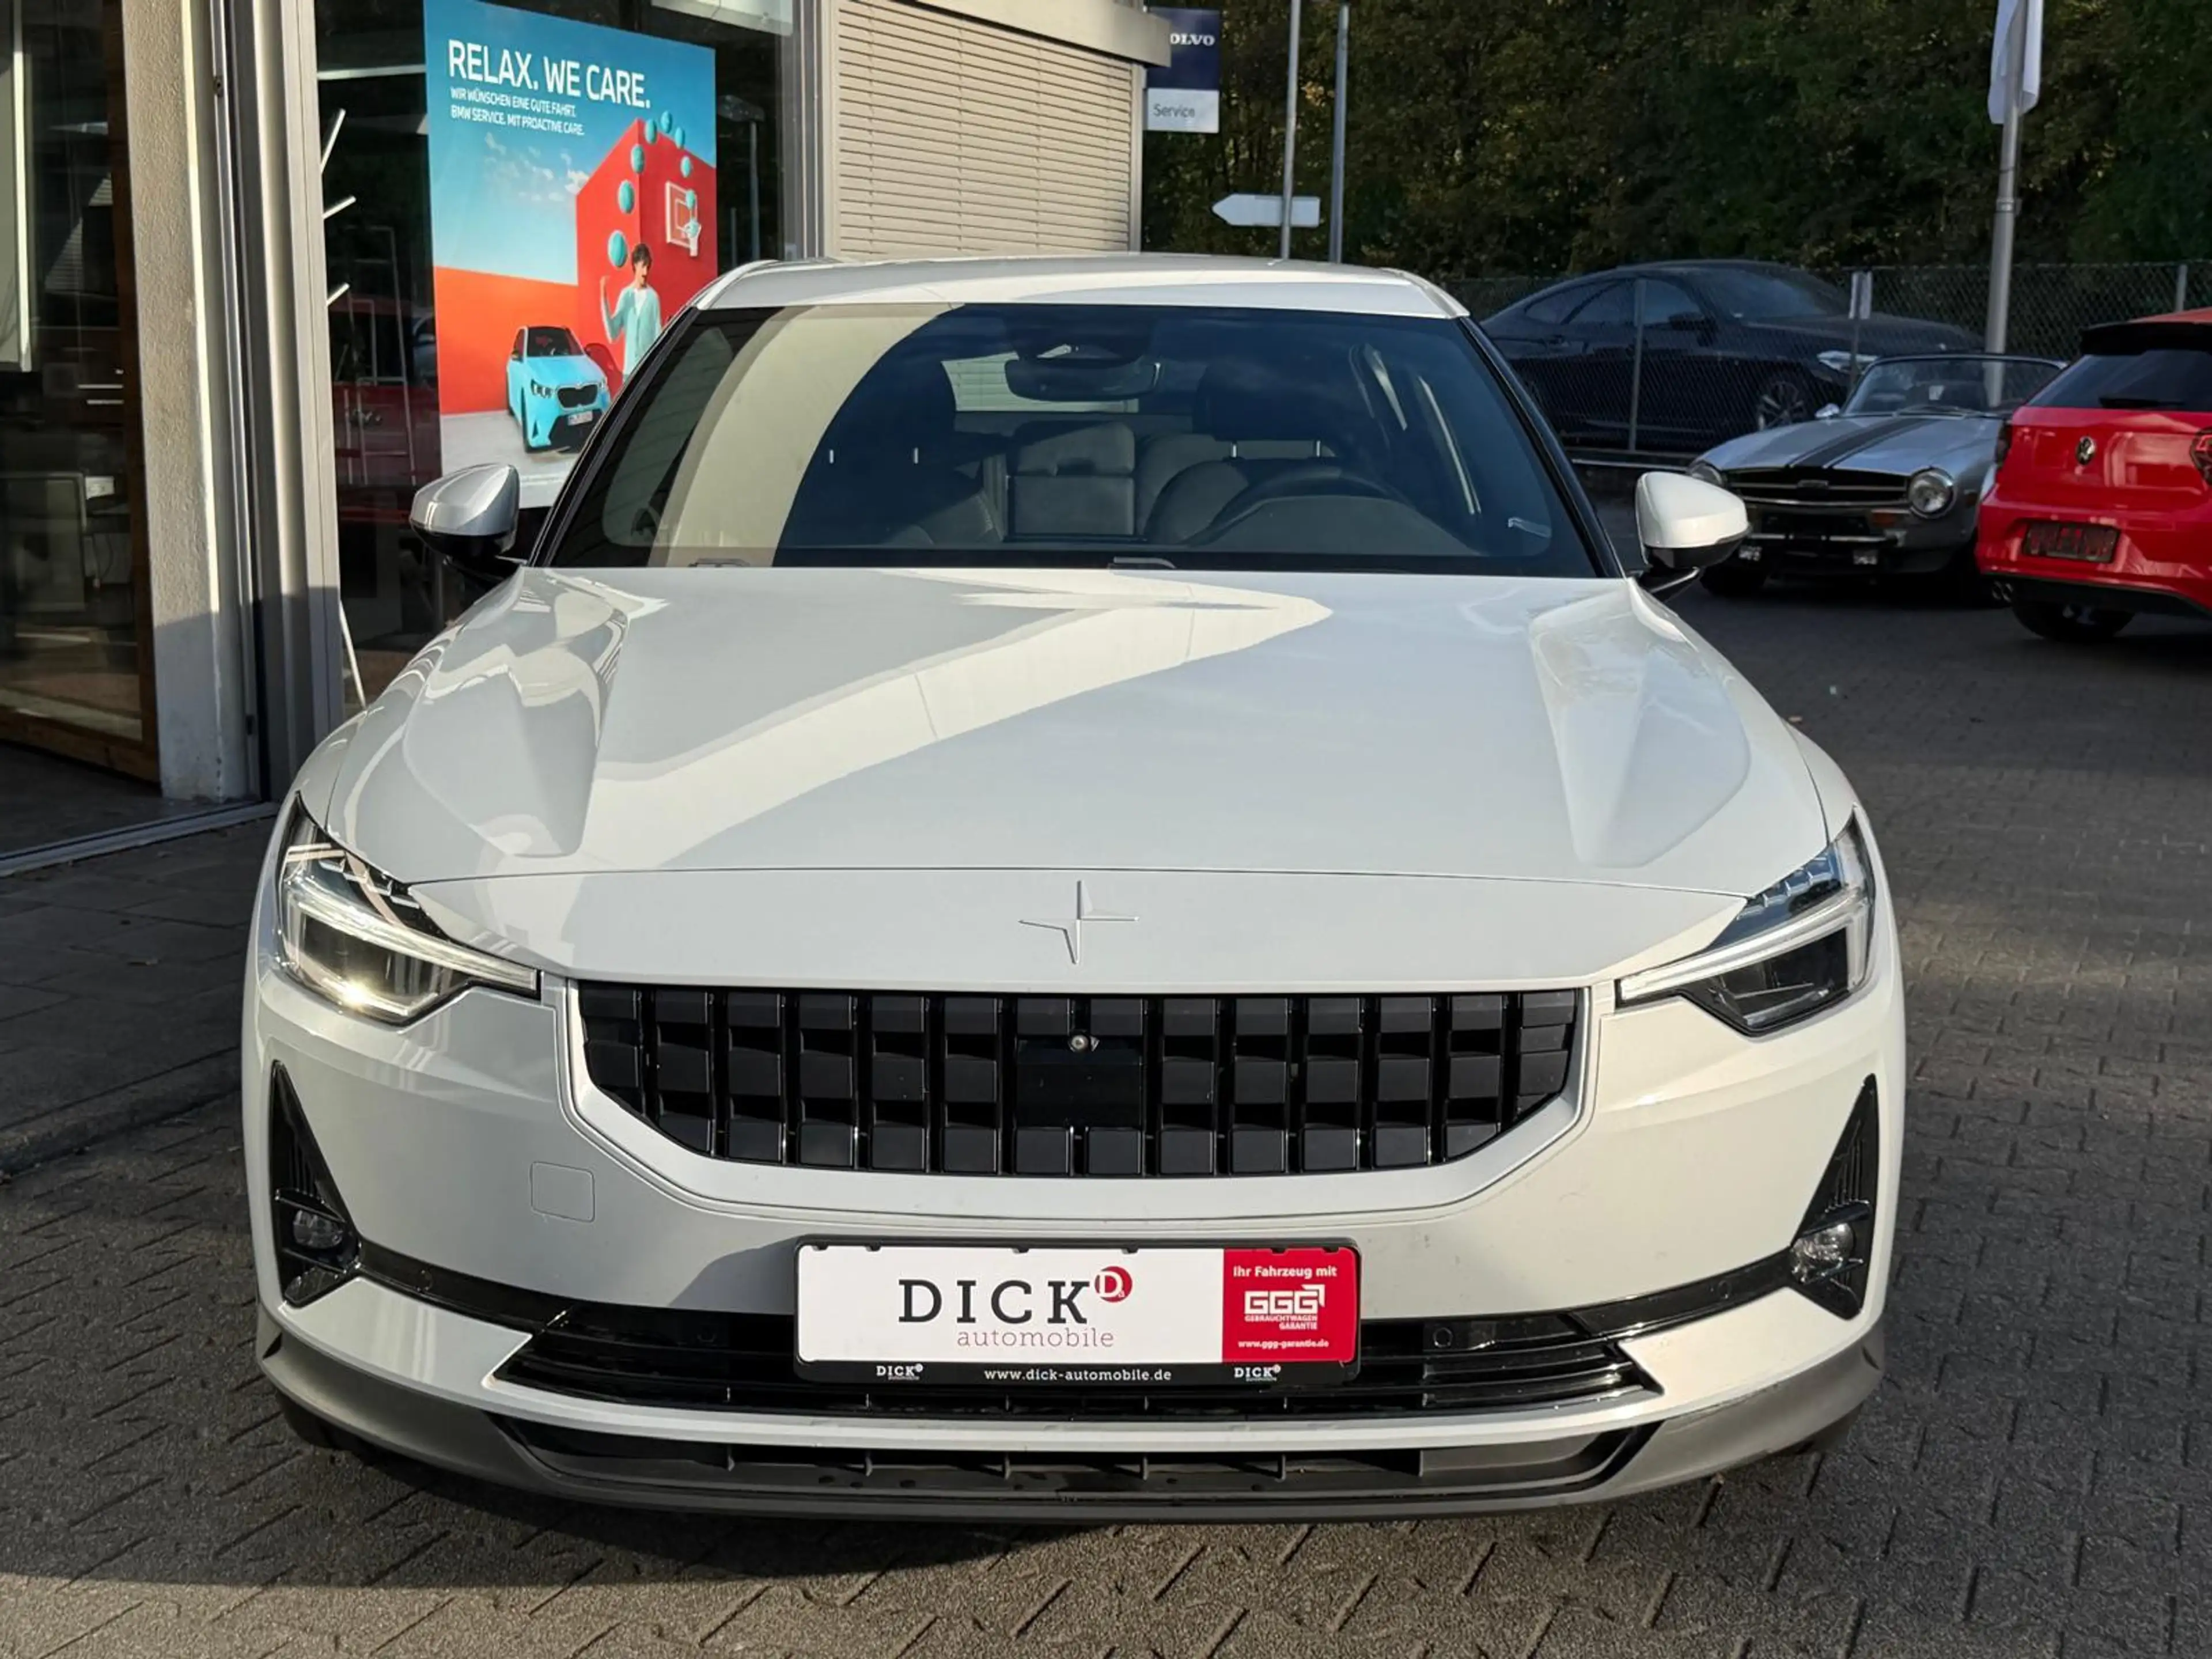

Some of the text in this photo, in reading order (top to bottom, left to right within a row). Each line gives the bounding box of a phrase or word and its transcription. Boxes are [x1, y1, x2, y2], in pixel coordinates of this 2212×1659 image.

[1170, 33, 1215, 46] OLVO
[449, 39, 651, 109] RELAX. WE CARE.
[450, 86, 467, 100] WIR
[467, 88, 511, 107] WÜNSCHEN
[512, 96, 529, 110] EINE
[531, 98, 551, 114] GUTE
[1154, 103, 1195, 118] Service
[451, 104, 471, 120] BMW
[507, 113, 521, 127] MIT
[521, 115, 563, 133] PROACTIVE
[1233, 1266, 1338, 1279] Ihr Fahrzeug mit
[899, 1279, 1090, 1324] DICK
[1244, 1290, 1319, 1314] GGG
[1278, 1322, 1318, 1330] GARANTIE
[957, 1327, 1114, 1347] automobile
[1238, 1338, 1330, 1349] www.ggg-garantie.de
[876, 1365, 915, 1377] DICK
[984, 1369, 1172, 1381] www.dick-automobile.de
[1234, 1367, 1273, 1378] DICK
